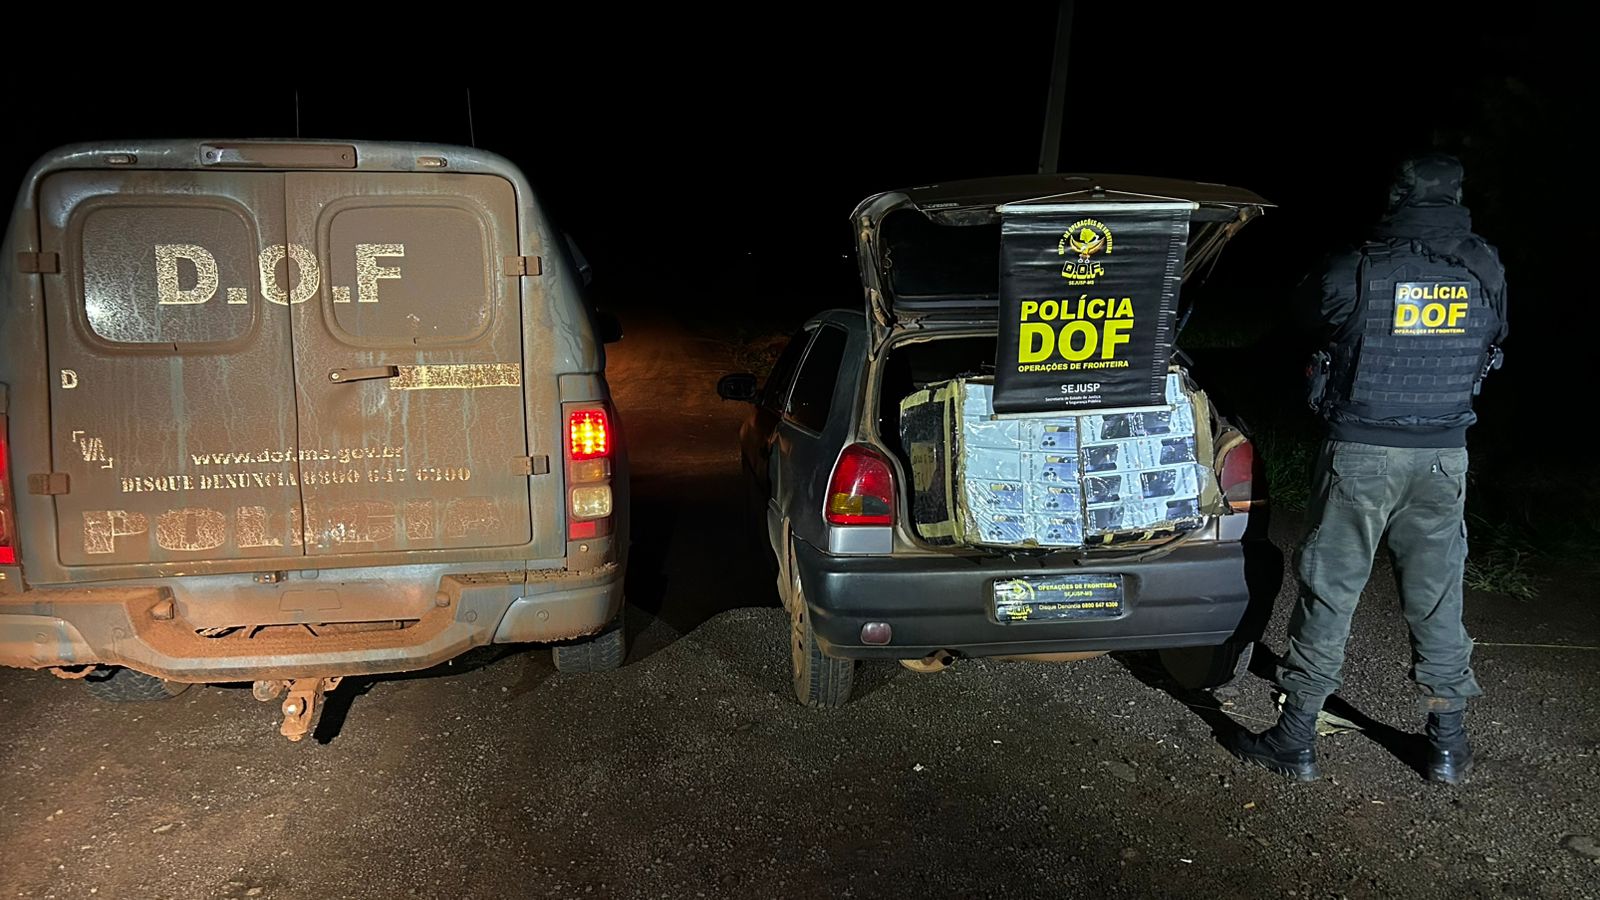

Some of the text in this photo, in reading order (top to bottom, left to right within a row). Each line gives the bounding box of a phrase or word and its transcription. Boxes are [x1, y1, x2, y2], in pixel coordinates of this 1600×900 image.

[154, 243, 405, 305] D.O.F
[1398, 283, 1469, 300] POLÍCIA
[1020, 294, 1135, 321] POLÍCIA
[1395, 303, 1468, 327] DOF
[1018, 319, 1135, 363] DOF
[1018, 360, 1129, 373] OPERAÇÕES DE FRONTEIRA
[1060, 383, 1101, 394] SEJUSP
[120, 474, 194, 493] DISQUE
